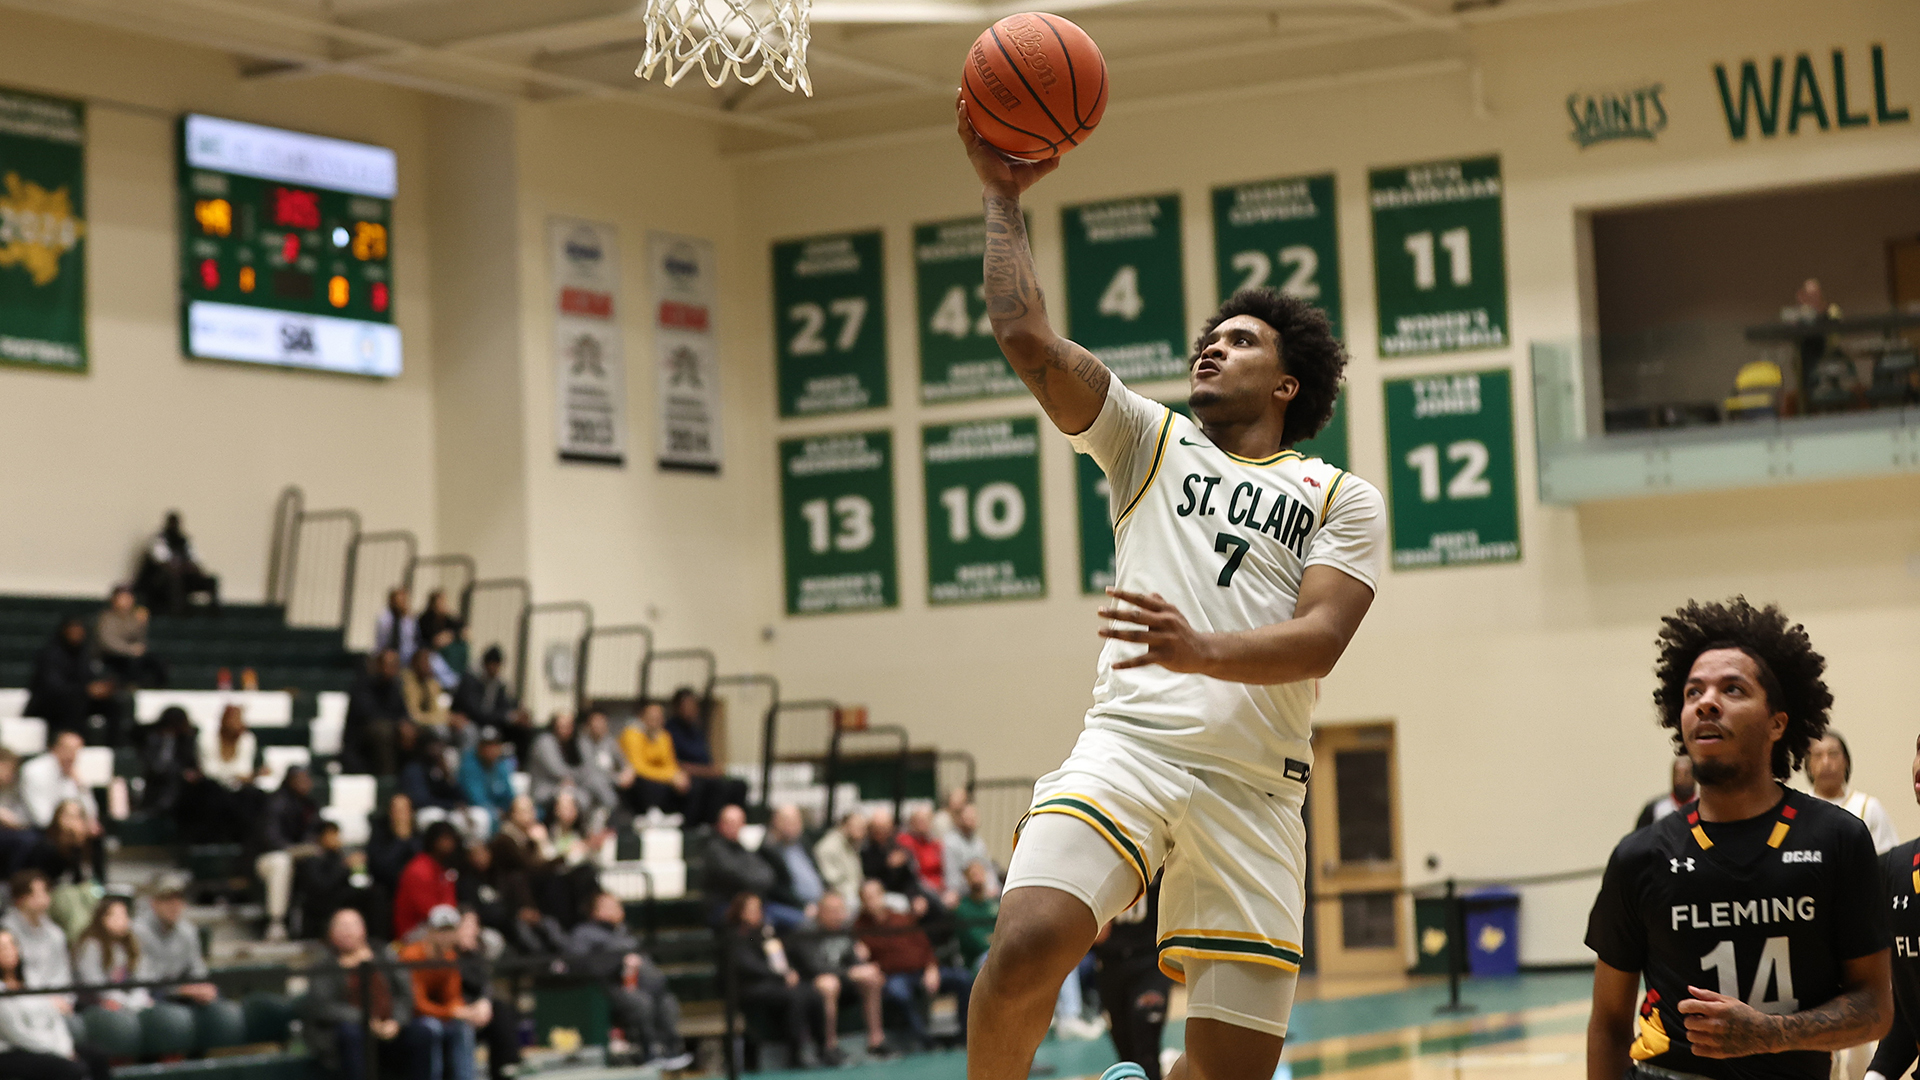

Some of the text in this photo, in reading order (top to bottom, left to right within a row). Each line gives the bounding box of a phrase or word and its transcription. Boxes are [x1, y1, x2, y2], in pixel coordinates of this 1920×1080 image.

[1566, 42, 1911, 149] SAINTS WALL
[1231, 244, 1321, 300] 22
[1404, 226, 1472, 291] 11
[929, 286, 995, 340] 4
[1098, 264, 1144, 322] 4
[789, 296, 869, 356] 27
[1405, 440, 1492, 502] 12
[801, 495, 875, 555] 13
[939, 482, 1026, 543] 10
[1177, 473, 1222, 517] ST.
[1227, 481, 1315, 560] CLAIR
[1214, 532, 1250, 588] 7
[1671, 896, 1816, 931] FLEMING
[1699, 935, 1800, 1015] 14
[1895, 936, 1920, 957] FL
